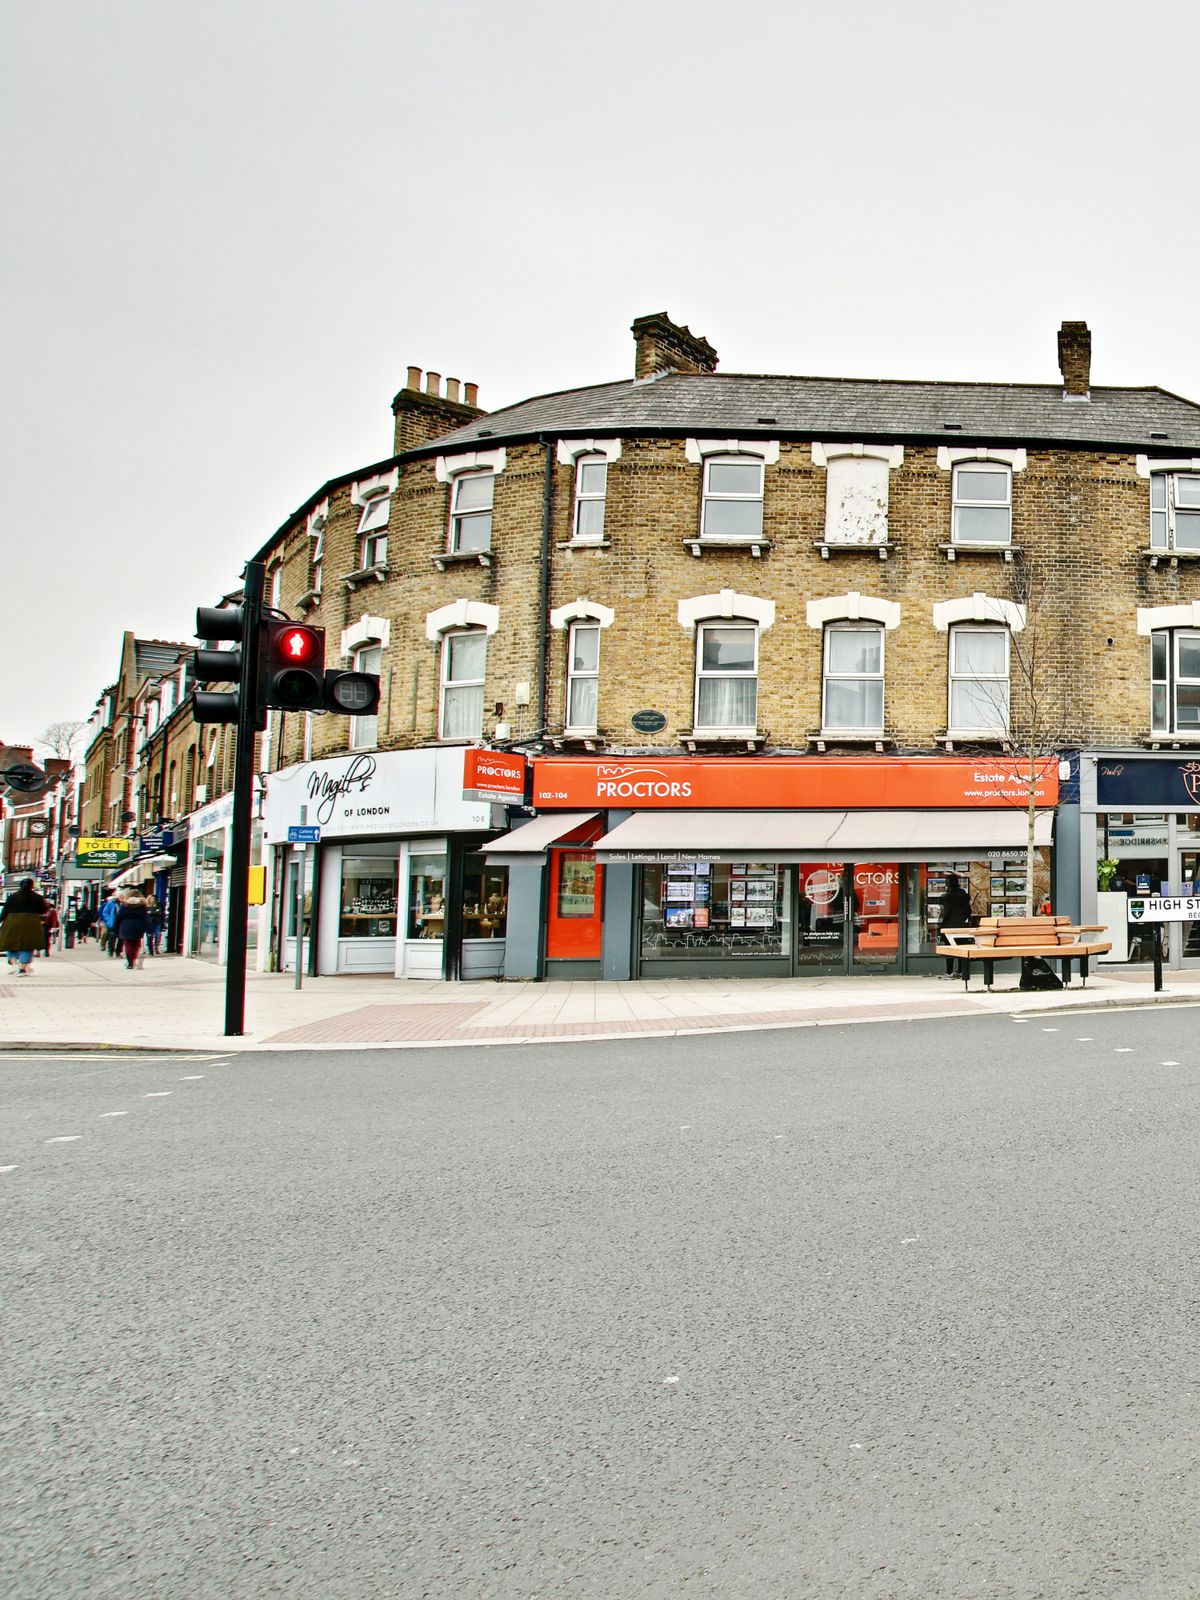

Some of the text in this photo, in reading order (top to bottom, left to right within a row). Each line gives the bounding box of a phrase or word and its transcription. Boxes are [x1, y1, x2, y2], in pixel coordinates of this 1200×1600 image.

[477, 765, 521, 779] PROCTORS
[974, 772, 1005, 782] Estate
[596, 782, 692, 797] PROCTORS
[964, 788, 1045, 797] www.proctors.lonon
[478, 792, 518, 802] Estate Agents
[344, 806, 390, 817] OF LONDON
[472, 815, 485, 823] 106
[631, 853, 656, 861] Lettings
[1149, 898, 1181, 910] HIGH
